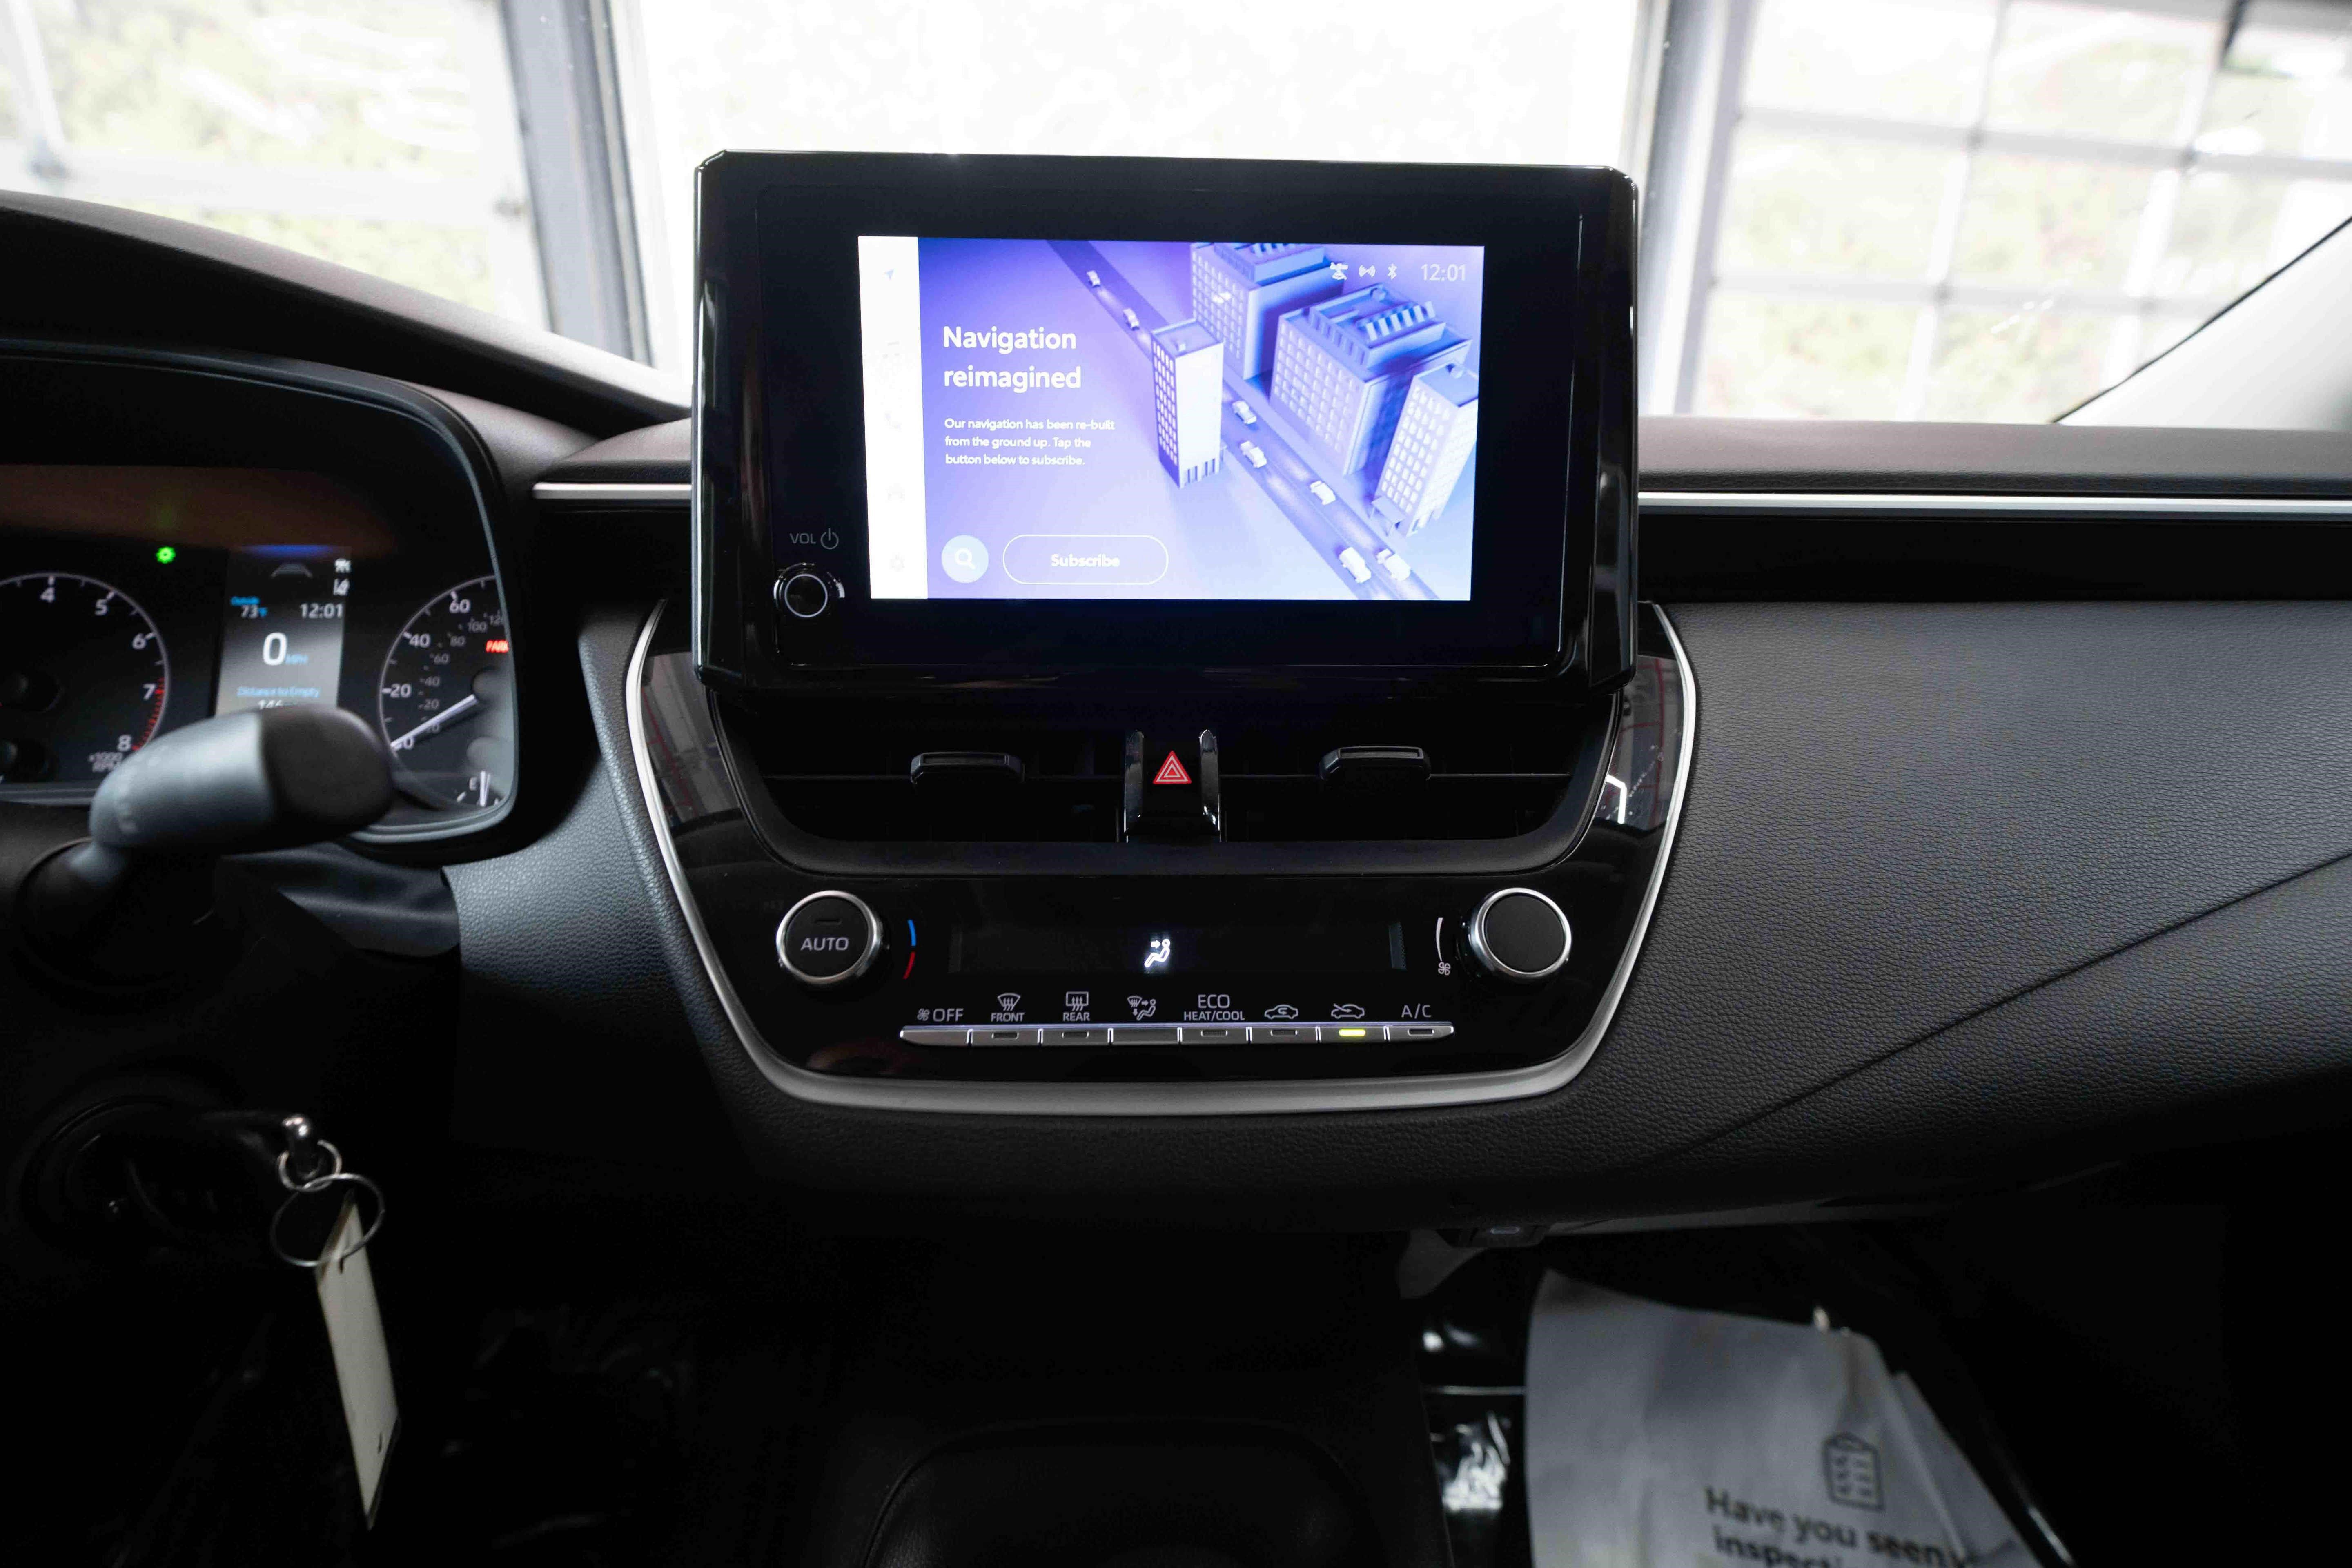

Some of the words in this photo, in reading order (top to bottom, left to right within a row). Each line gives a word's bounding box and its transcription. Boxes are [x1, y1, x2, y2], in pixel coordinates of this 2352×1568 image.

[1421, 263, 1466, 281] 12:01
[943, 325, 1076, 354] Navigation
[944, 365, 1081, 393] reimagined
[944, 418, 966, 429] Our
[968, 419, 1023, 431] navigation
[1025, 419, 1044, 429] has
[1046, 420, 1073, 429] been
[1075, 420, 1115, 430] re-built
[945, 436, 970, 446] from
[972, 437, 989, 446] the
[991, 437, 1031, 449] ground
[1033, 439, 1051, 449] up.
[1053, 437, 1071, 449] Tap
[1074, 438, 1091, 448] the
[945, 454, 981, 464] button
[983, 454, 1016, 464] below
[1018, 455, 1030, 464] to
[1031, 455, 1085, 465] subscribe.
[789, 532, 816, 544] VOL
[1051, 553, 1120, 567] Subscribe
[40, 587, 56, 603] 4
[94, 598, 108, 615] 5
[300, 603, 343, 619] 12:01
[450, 599, 470, 613] 60
[131, 633, 147, 650] 6
[409, 633, 431, 648] 40
[263, 632, 287, 666] 0
[142, 684, 157, 700] 7
[390, 683, 412, 698] 20
[117, 734, 132, 751] 8
[800, 937, 849, 951] AUTO
[1198, 994, 1230, 1009] ECO
[933, 1008, 964, 1021] OFF
[991, 1012, 1025, 1022] FRONT
[1063, 1012, 1090, 1021] REAR
[1184, 1011, 1245, 1021] HEAT/COOL
[1402, 1003, 1432, 1019] A/C
[1704, 1484, 1785, 1529] Have
[1793, 1512, 1858, 1548] you
